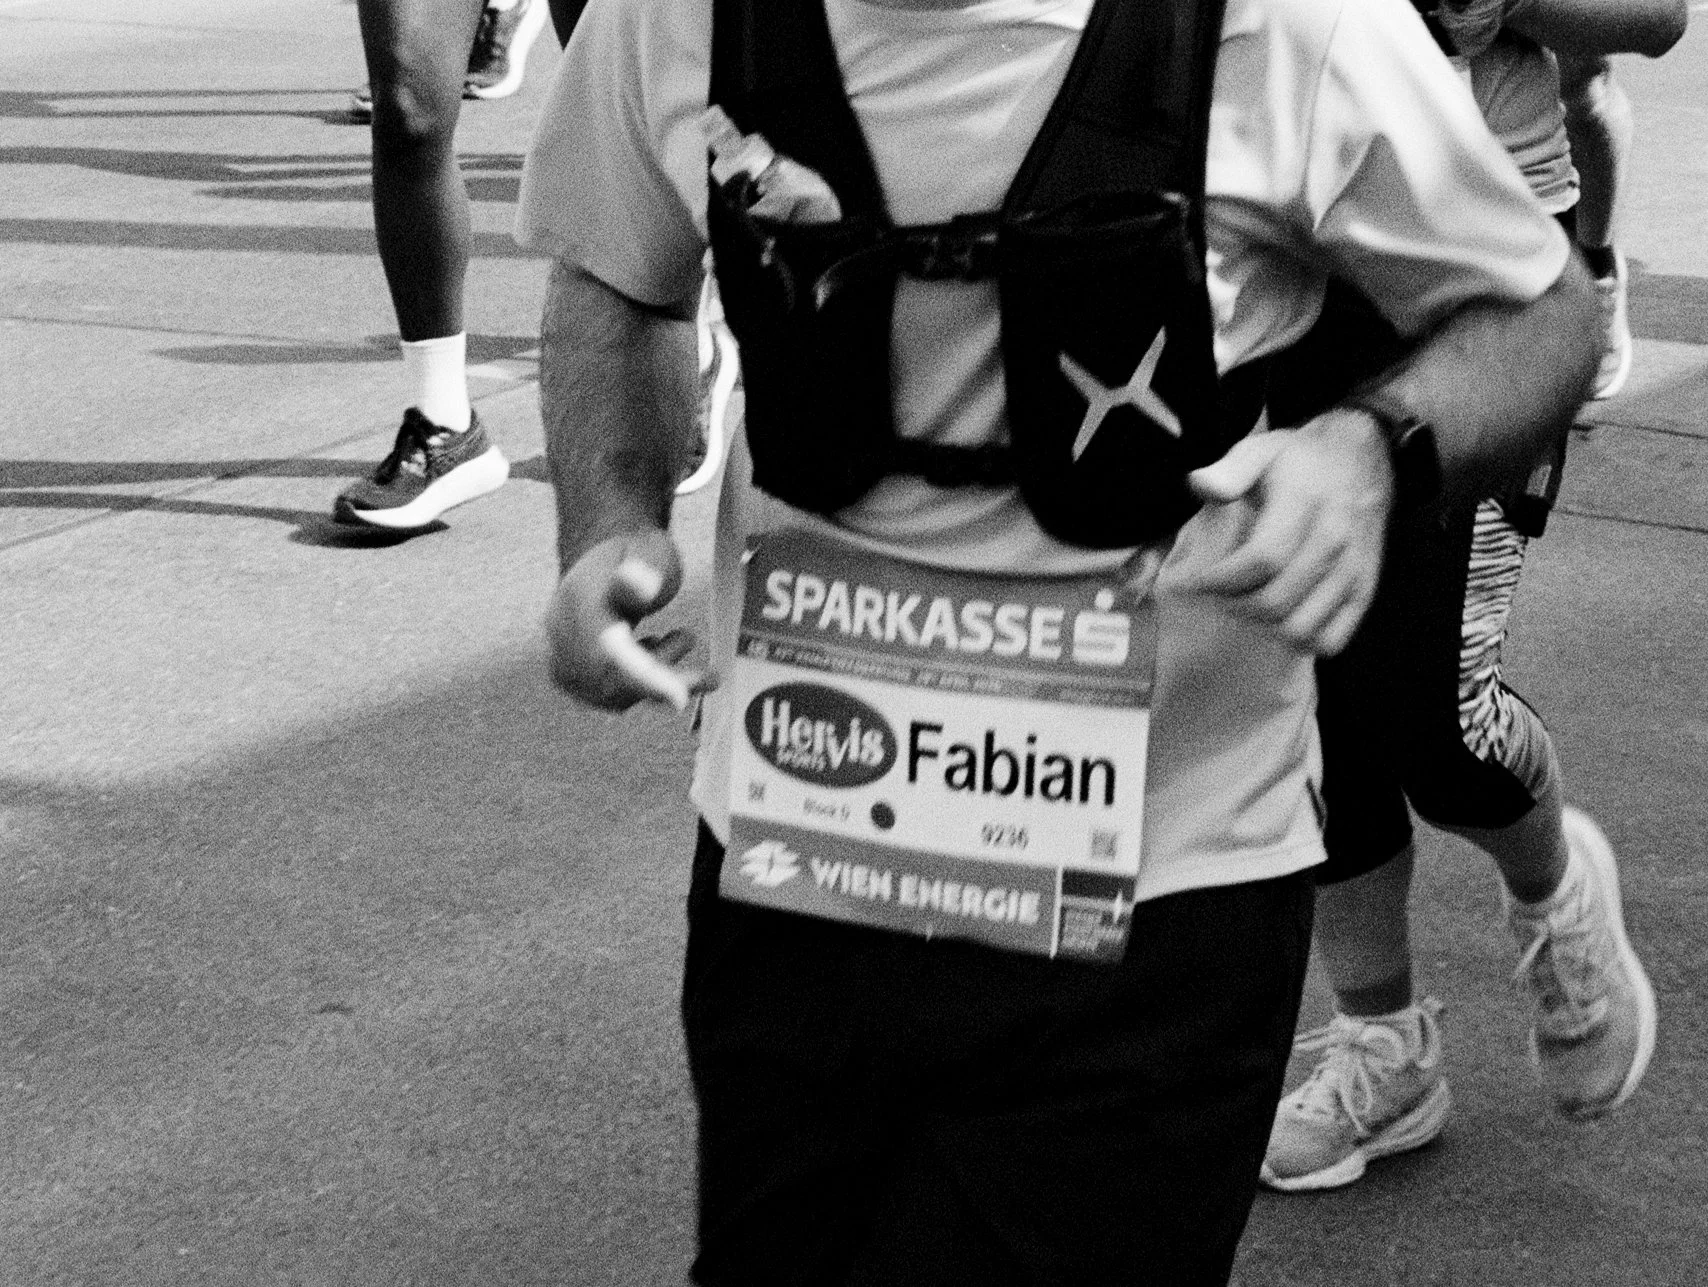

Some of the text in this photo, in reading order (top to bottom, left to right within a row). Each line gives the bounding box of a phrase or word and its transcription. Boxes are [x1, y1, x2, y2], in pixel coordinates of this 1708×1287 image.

[762, 569, 1063, 661] SPARKASSE
[760, 696, 886, 771] Hervis
[907, 721, 1117, 806] Fabian
[811, 855, 1042, 926] WIEN ENERGIE
